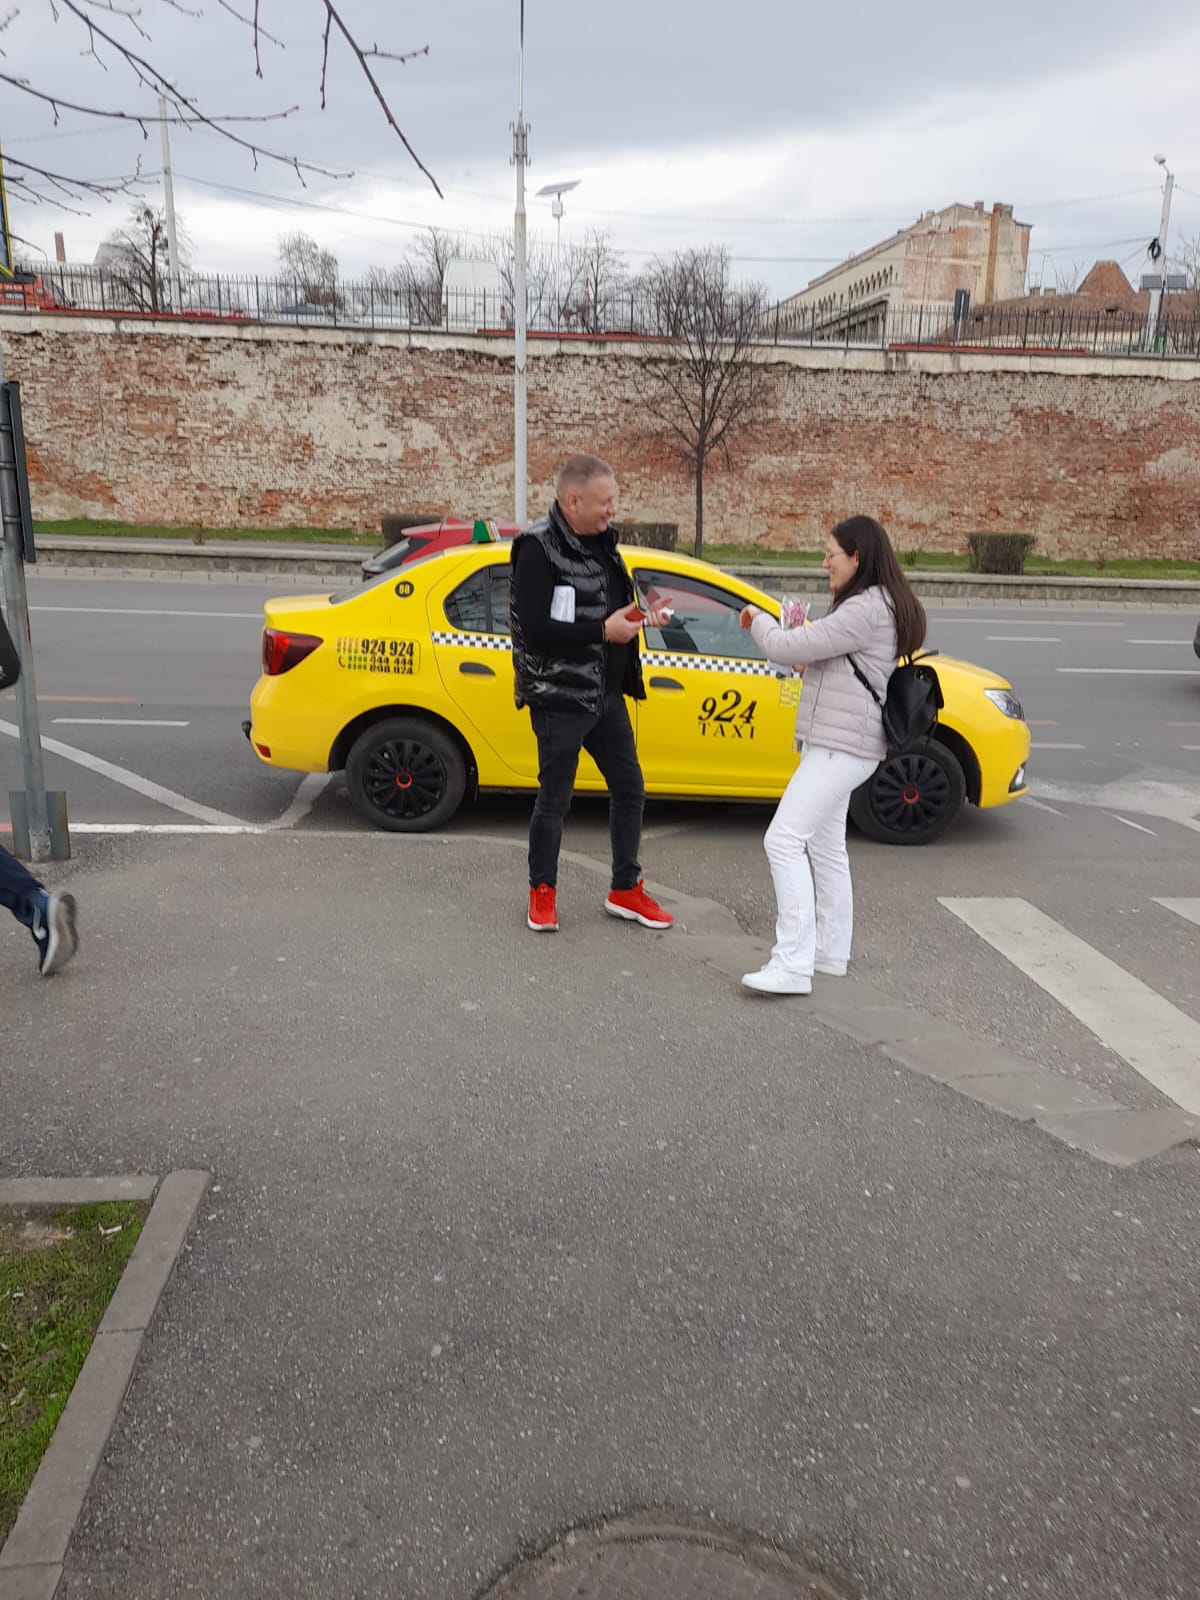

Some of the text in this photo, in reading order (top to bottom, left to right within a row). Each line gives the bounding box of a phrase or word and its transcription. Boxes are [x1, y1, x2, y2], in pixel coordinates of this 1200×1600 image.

[361, 638, 386, 655] 924
[389, 641, 414, 657] 924
[698, 689, 757, 724] 924
[698, 721, 755, 739] TAXI
